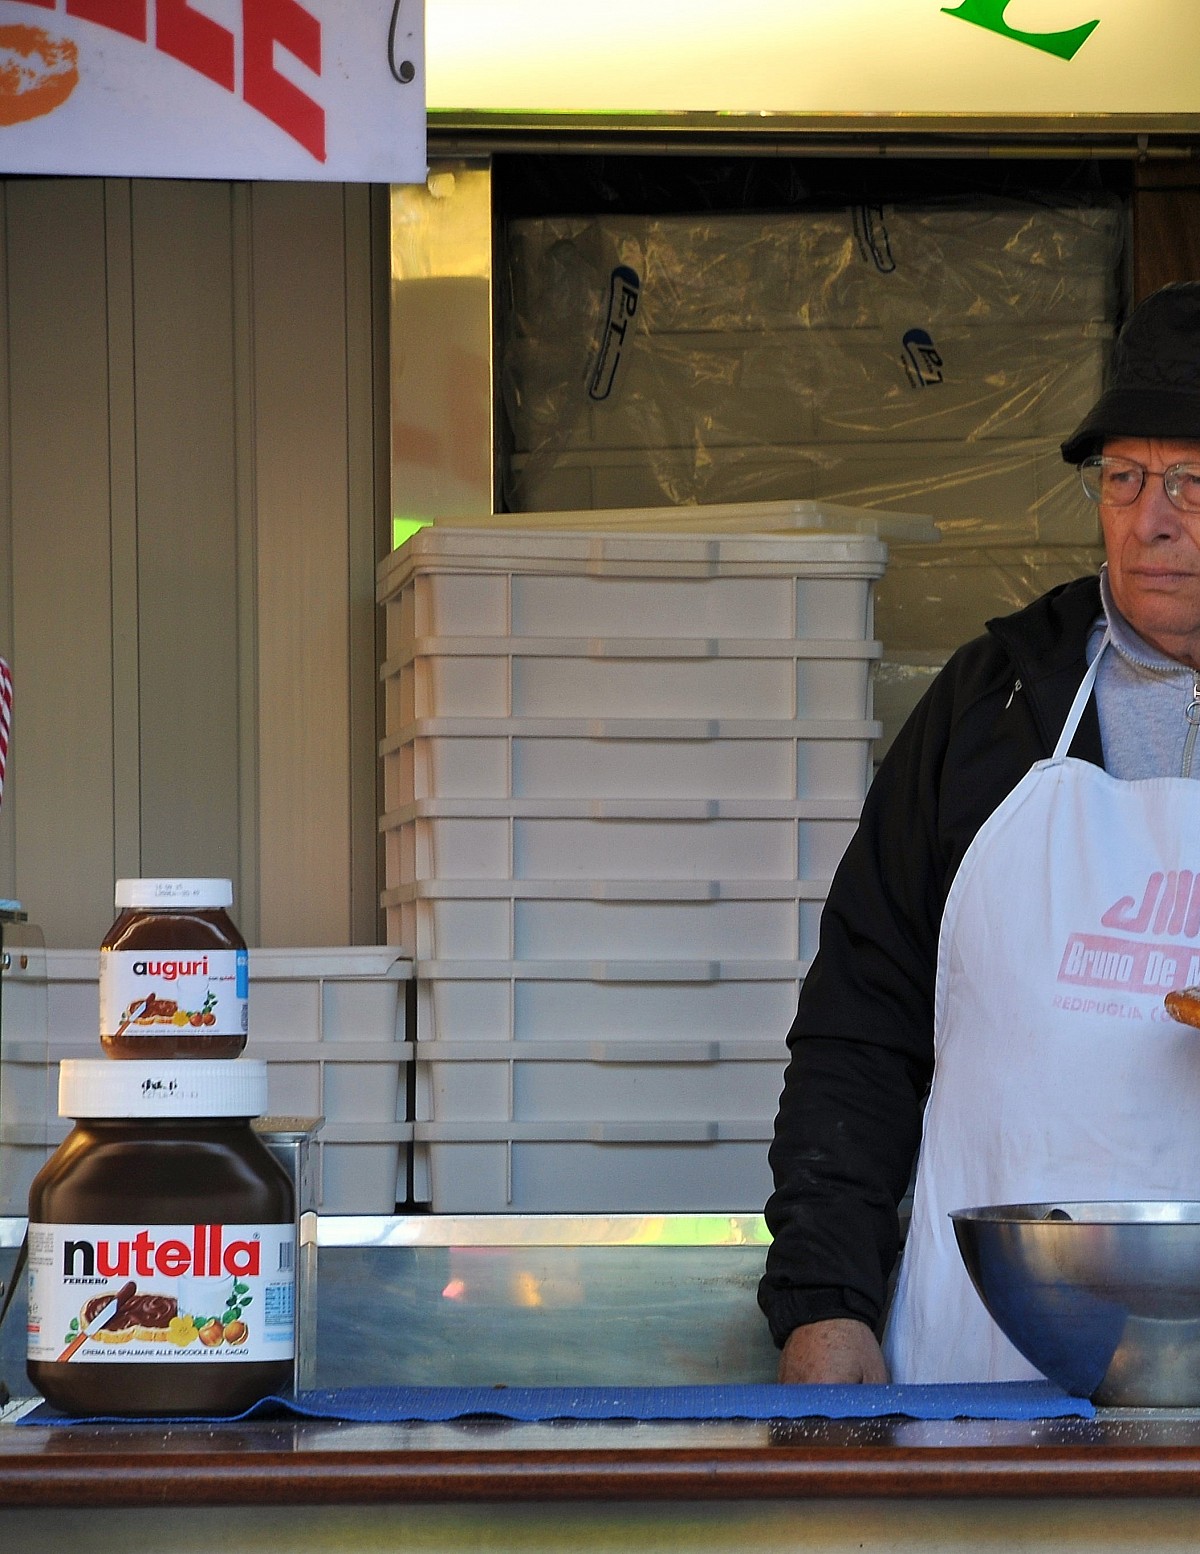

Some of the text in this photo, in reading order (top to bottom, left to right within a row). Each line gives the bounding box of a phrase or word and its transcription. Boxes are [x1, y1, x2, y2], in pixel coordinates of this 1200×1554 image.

[133, 955, 209, 981] auguri
[1065, 941, 1134, 983] Bruno
[1143, 951, 1177, 988] De
[1052, 996, 1143, 1020] REDIPUGLIA
[64, 1225, 260, 1277] nutella
[82, 1348, 105, 1356] CREMA
